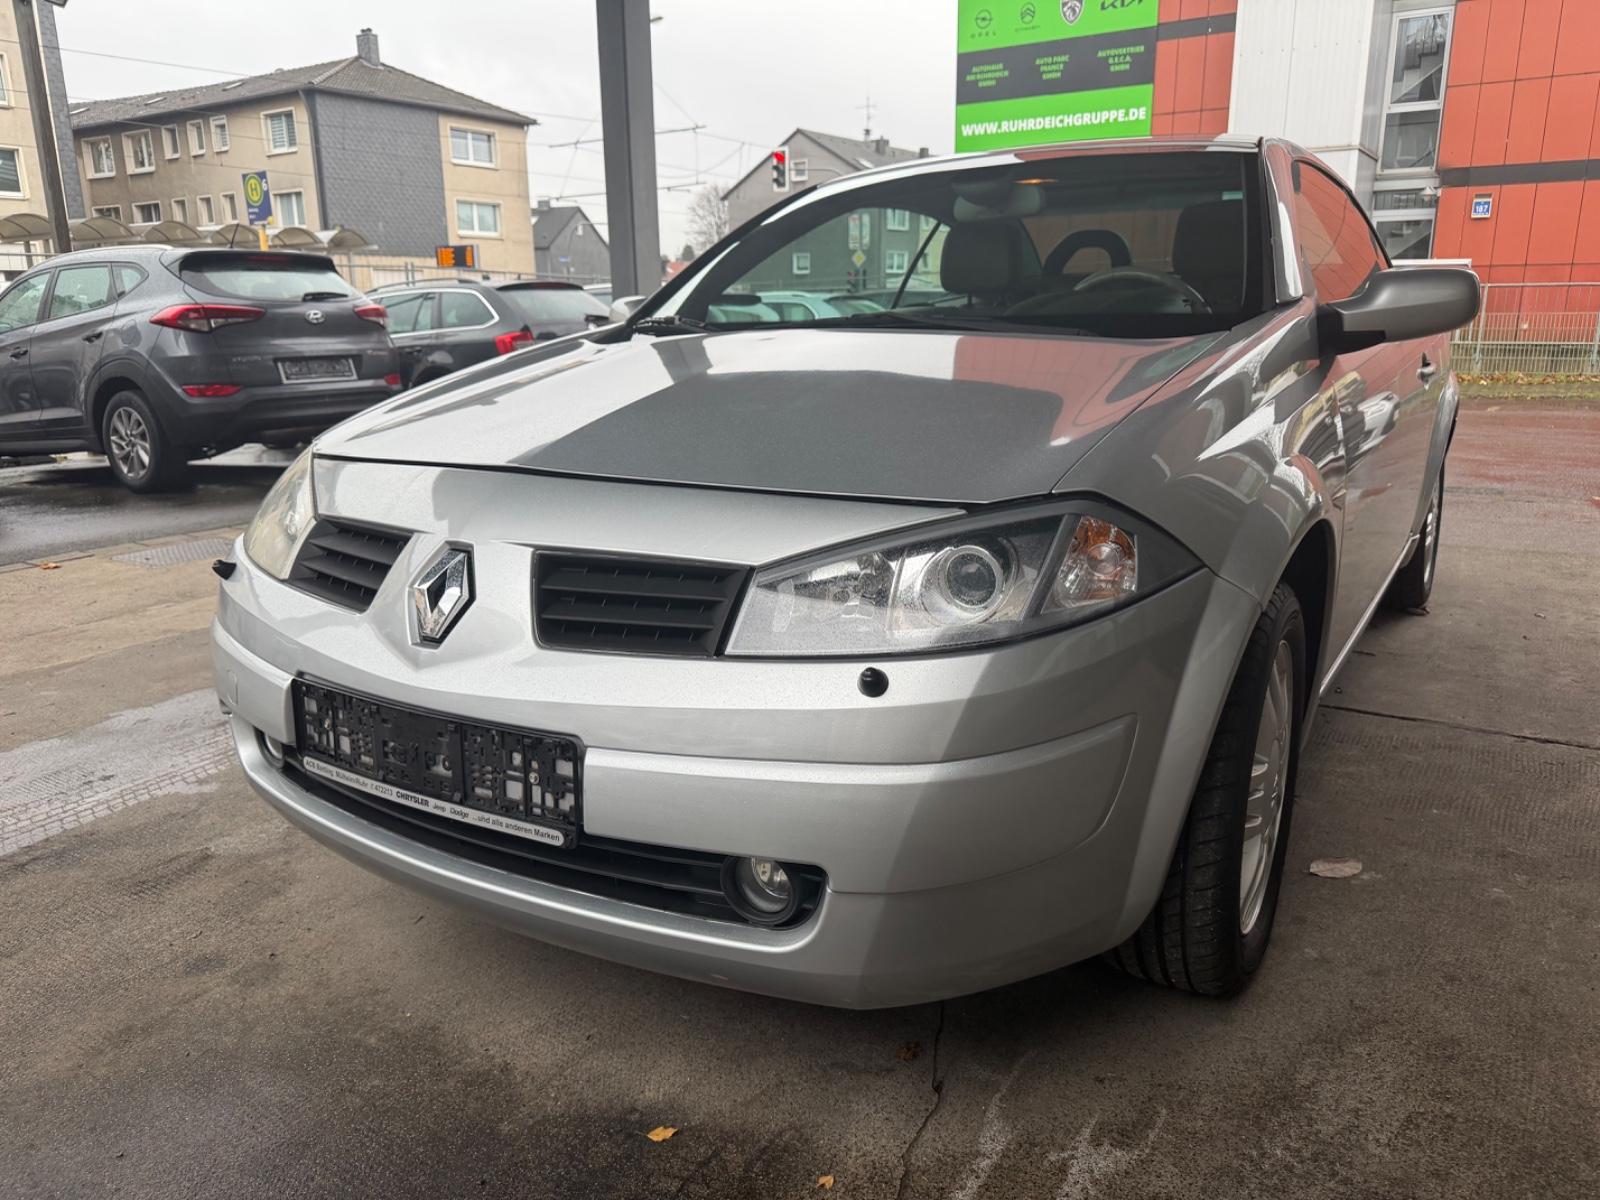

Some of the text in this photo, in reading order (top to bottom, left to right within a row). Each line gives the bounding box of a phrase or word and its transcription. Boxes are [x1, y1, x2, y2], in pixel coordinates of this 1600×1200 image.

[961, 107, 1147, 137] WWW.RUHRDEICHGRUPPE.DE
[395, 790, 430, 807] CHRYSLER
[432, 802, 447, 813] Jeep
[449, 808, 469, 819] Dodge
[491, 818, 504, 828] alle
[504, 821, 533, 835] anderen
[533, 828, 560, 842] Marken
